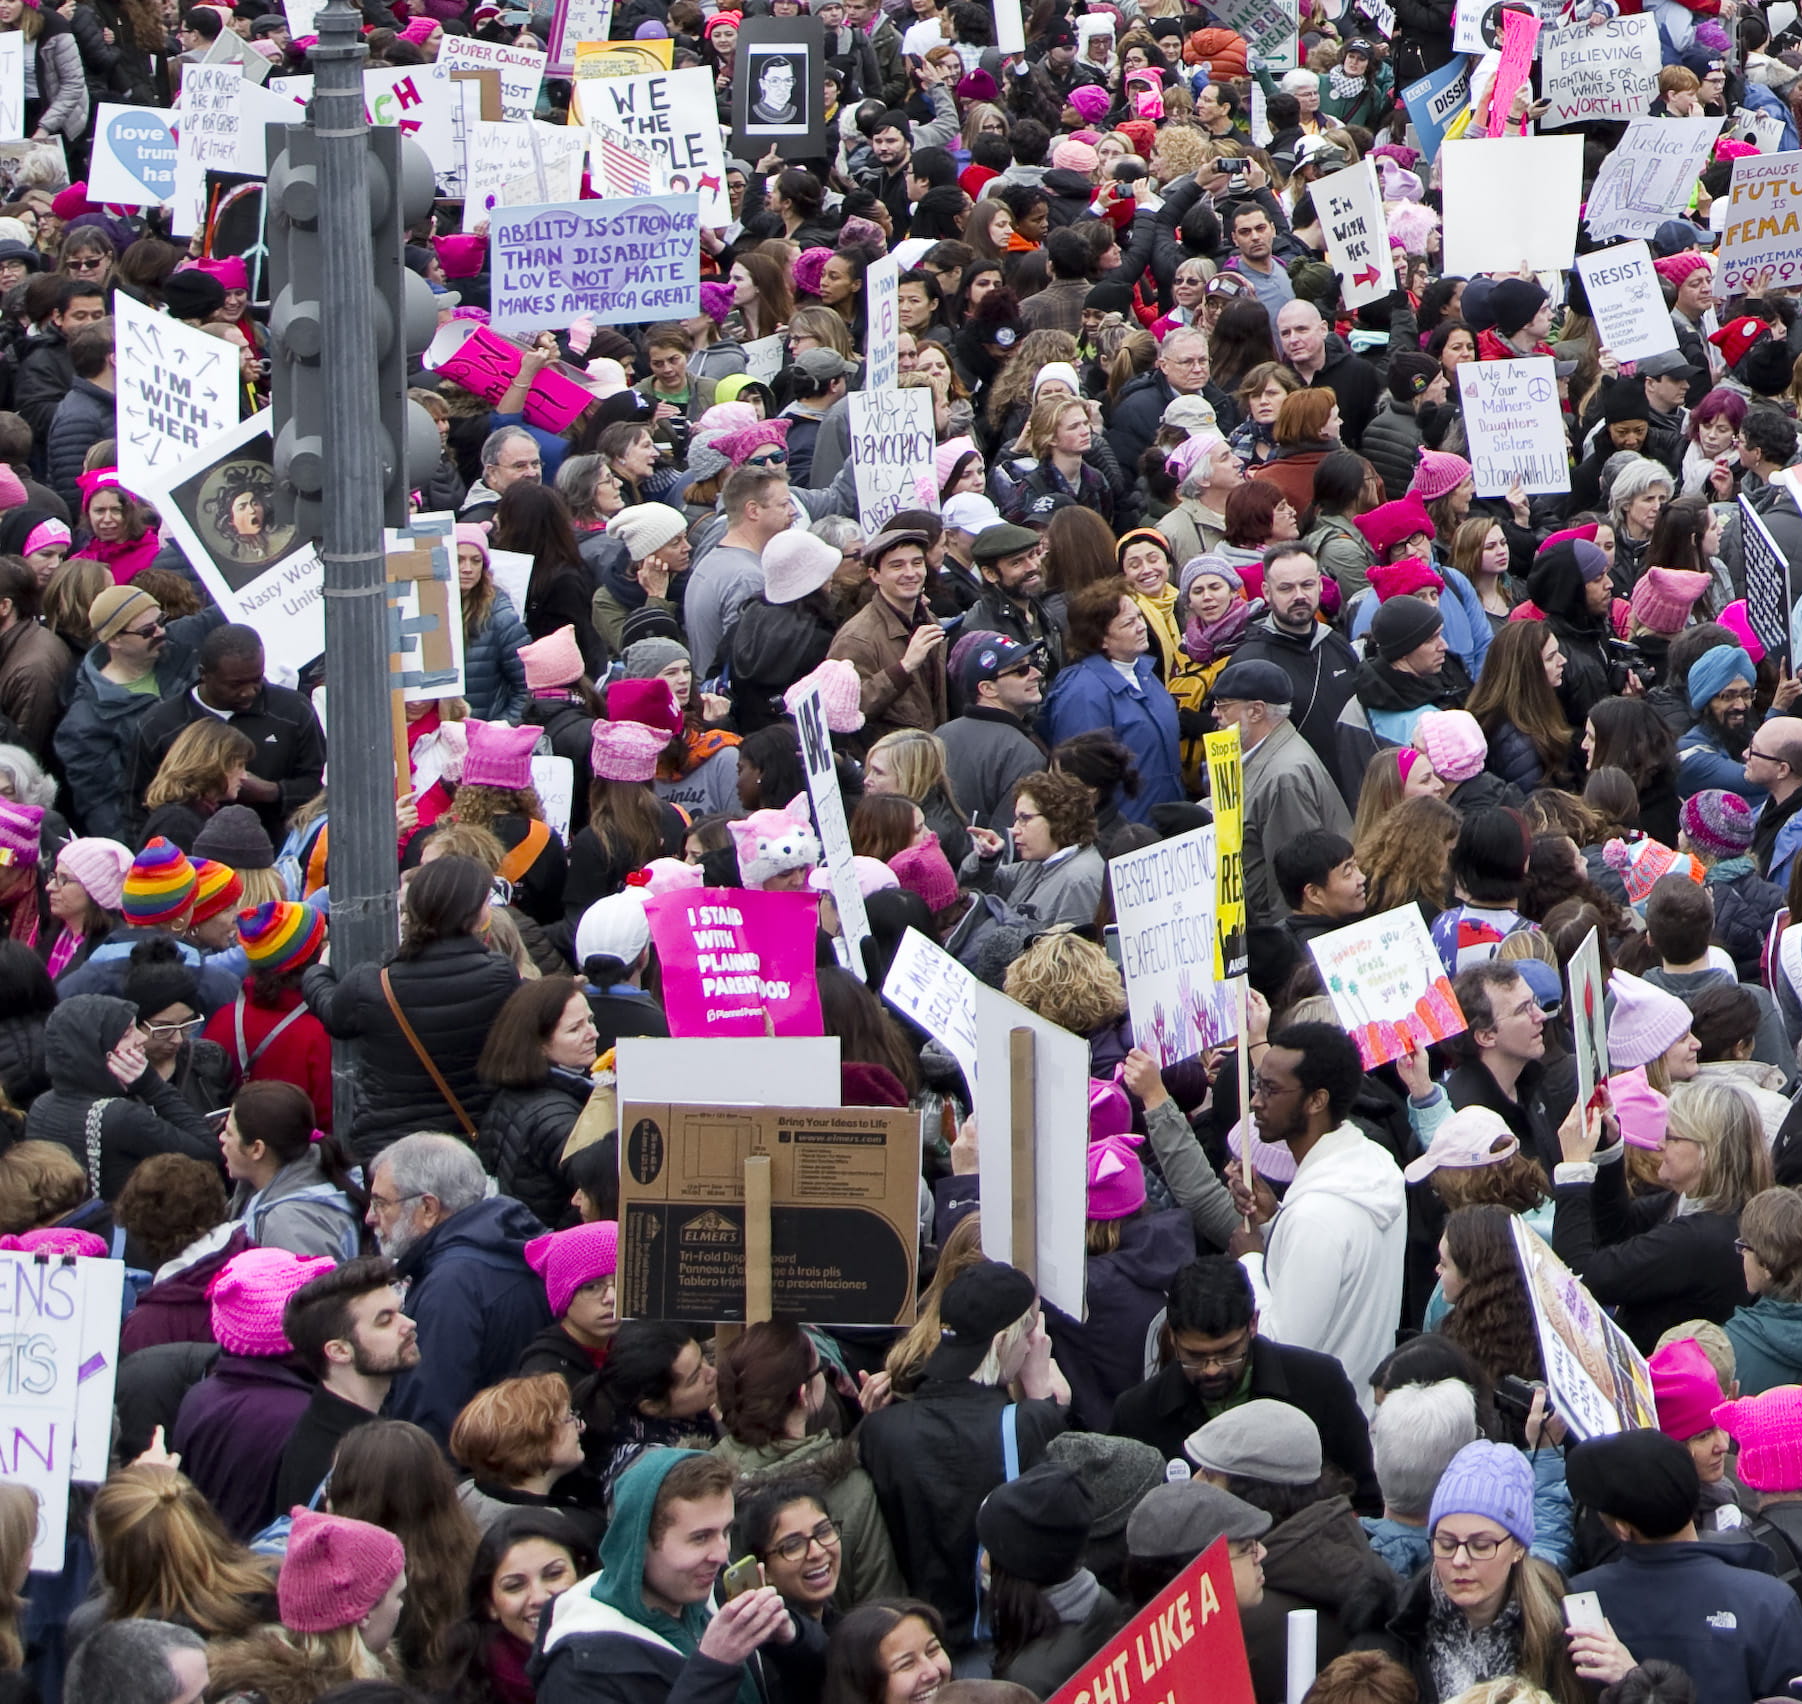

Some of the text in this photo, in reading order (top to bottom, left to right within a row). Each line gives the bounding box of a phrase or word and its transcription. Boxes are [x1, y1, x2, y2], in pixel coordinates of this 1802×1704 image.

[1550, 19, 1647, 49] NEVER STOP
[1560, 45, 1642, 70] BELIEVING
[1549, 67, 1637, 93] FIGHTING FOR
[1622, 73, 1660, 95] RIGHT
[609, 78, 671, 114] WE
[1557, 96, 1642, 120] WORTH IT
[621, 114, 671, 135] THE
[1736, 162, 1802, 181] BECAUSE
[1771, 198, 1787, 210] IS
[498, 212, 698, 244] ABILITY IS STRONGER
[501, 246, 562, 270] THAN
[504, 262, 685, 290] LOVE NOT HATE
[499, 294, 555, 316] MAKES
[562, 291, 637, 313] AMERICA
[152, 365, 191, 399] I'M
[139, 380, 209, 430] WITH
[147, 410, 200, 448] HER
[688, 908, 697, 926] I
[692, 929, 735, 950] WITH
[778, 1117, 804, 1127] Bring
[806, 1118, 830, 1127] Your
[832, 1118, 858, 1128] Ideas
[870, 1120, 888, 1128] Life
[799, 1135, 882, 1143] www.elmers.com
[684, 1231, 737, 1242] ELMER'S
